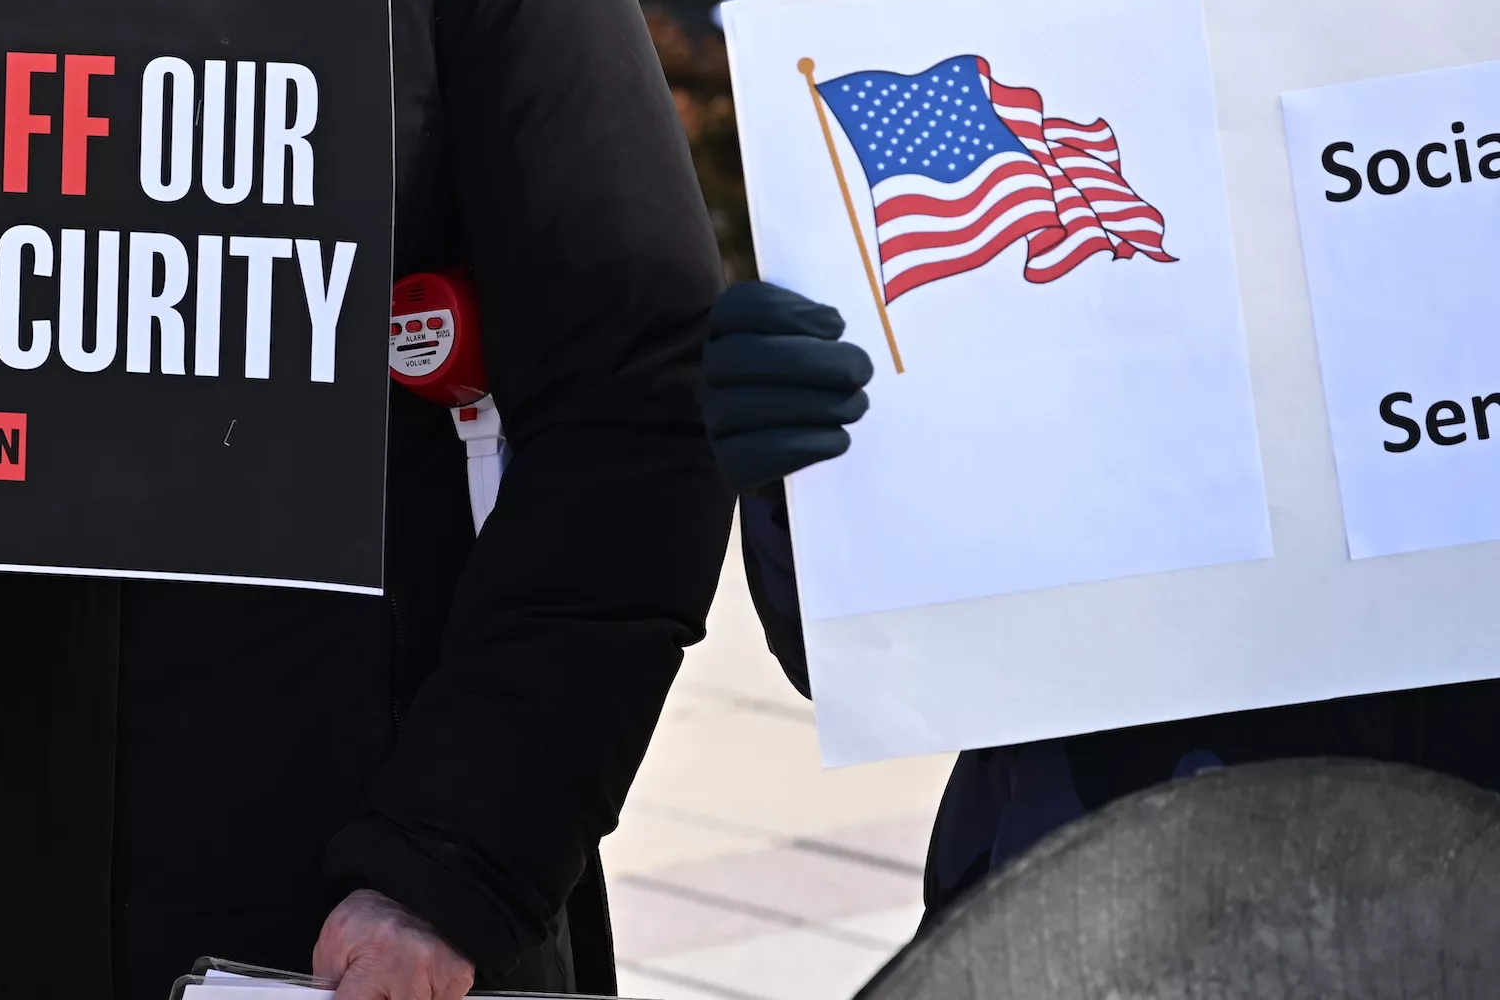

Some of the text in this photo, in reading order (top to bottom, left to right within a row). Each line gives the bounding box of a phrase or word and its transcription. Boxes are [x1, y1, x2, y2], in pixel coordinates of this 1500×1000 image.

[140, 56, 318, 206] OUR
[406, 334, 426, 342] ALARM
[405, 358, 432, 367] VOLUME
